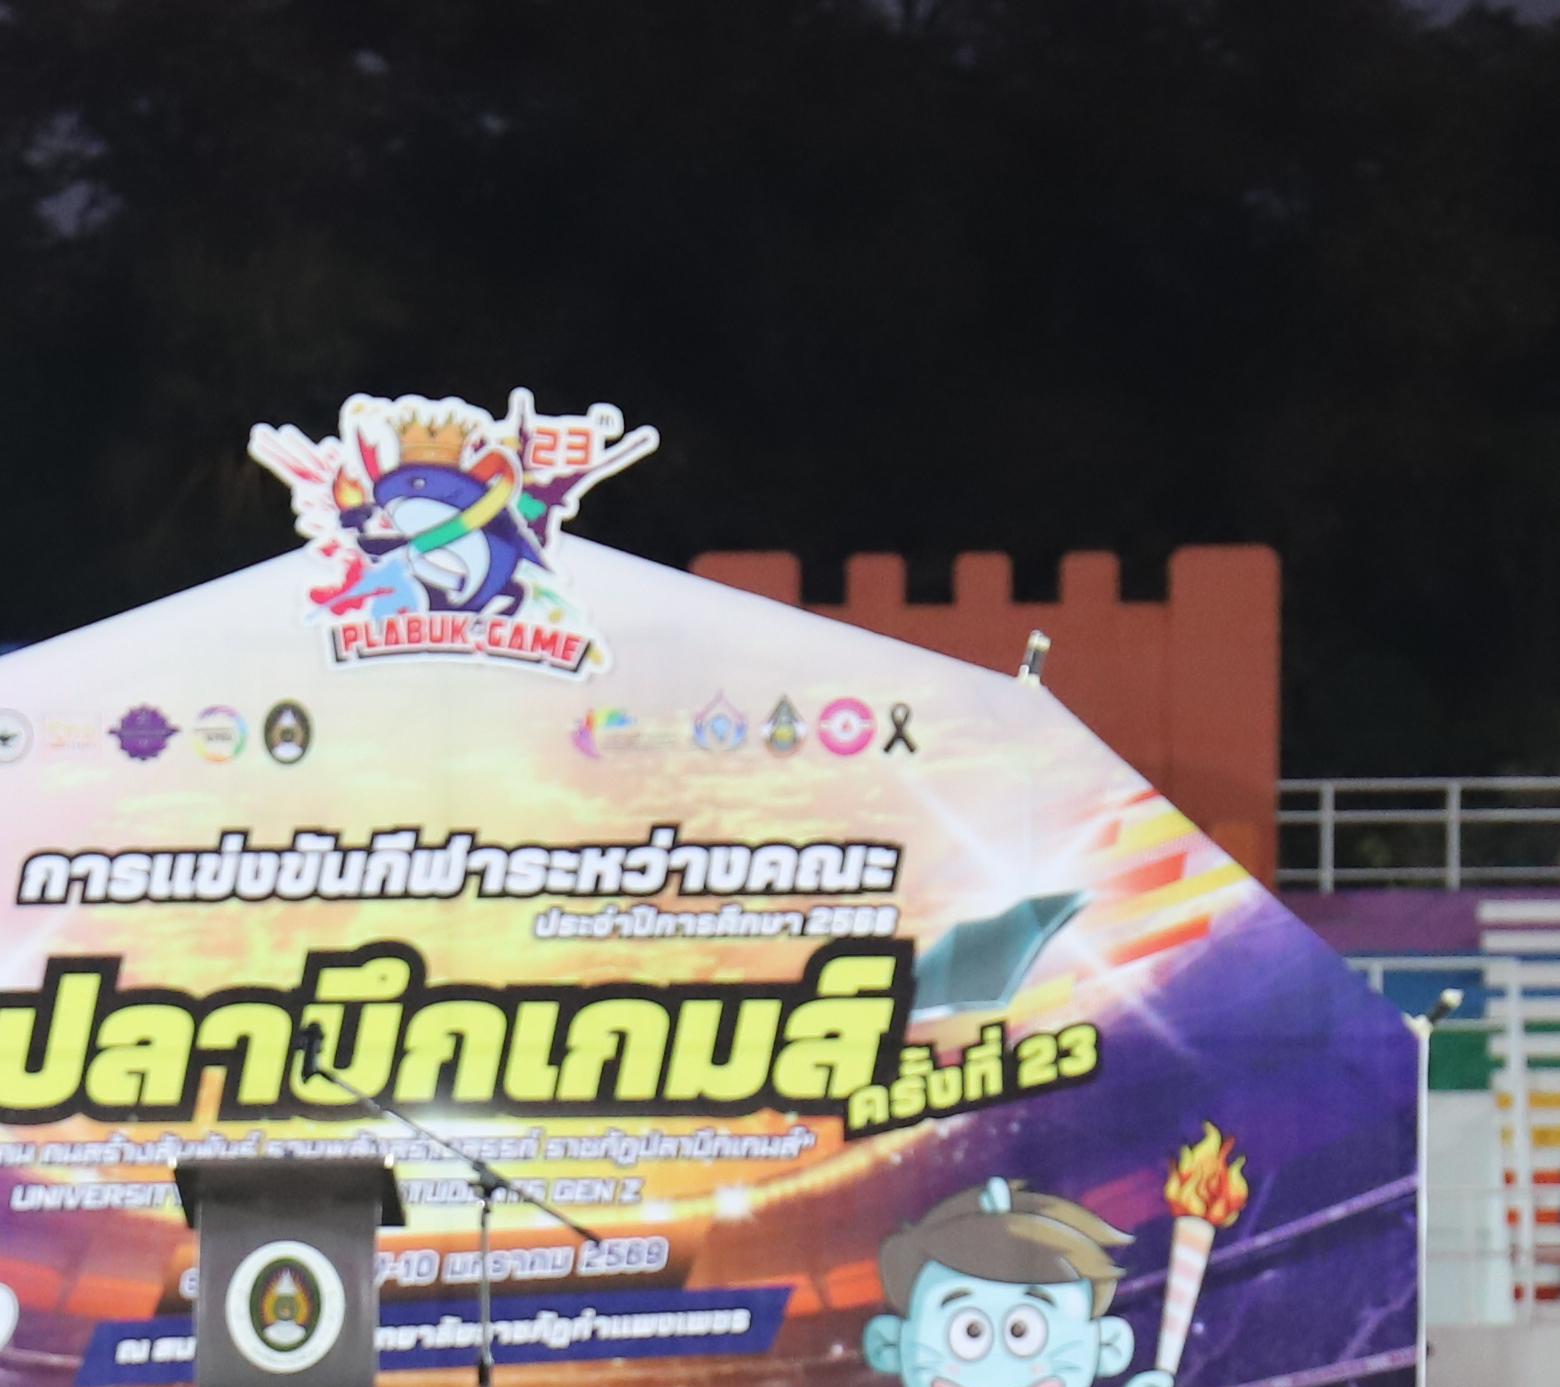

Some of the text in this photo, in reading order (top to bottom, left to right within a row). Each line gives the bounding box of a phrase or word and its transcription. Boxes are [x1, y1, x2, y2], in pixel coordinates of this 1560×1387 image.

[485, 615, 585, 666] GAME
[18, 826, 901, 904] การแข่งขันกีฬาระหว่างคณะ
[847, 1023, 1099, 1131] ครั้งที่ 23
